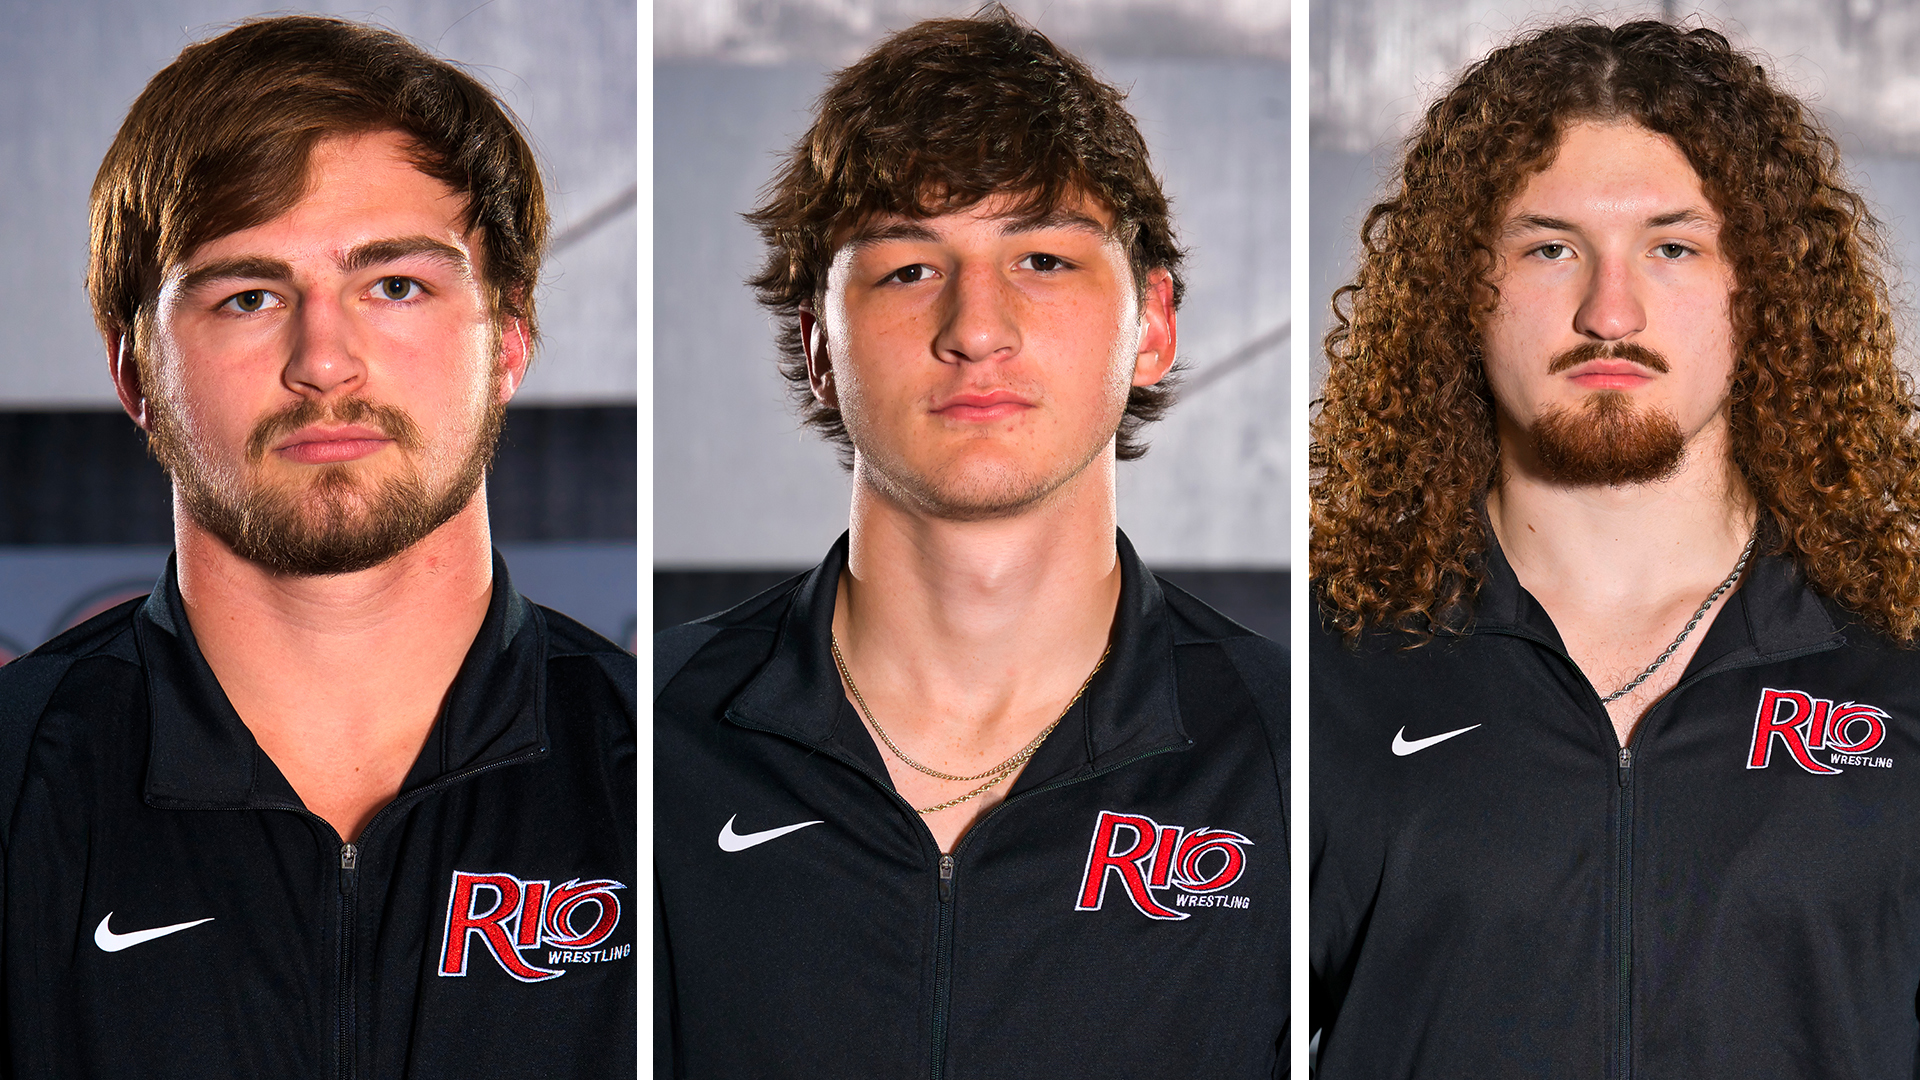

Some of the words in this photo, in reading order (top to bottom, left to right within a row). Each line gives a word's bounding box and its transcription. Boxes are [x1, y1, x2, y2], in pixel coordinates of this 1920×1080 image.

[1746, 687, 1893, 775] RIO
[1830, 753, 1894, 769] WRESTLING
[1074, 810, 1256, 921] RIO
[438, 870, 627, 983] RIO
[1176, 894, 1251, 909] WRESTLING
[548, 943, 631, 965] WRESTLING
